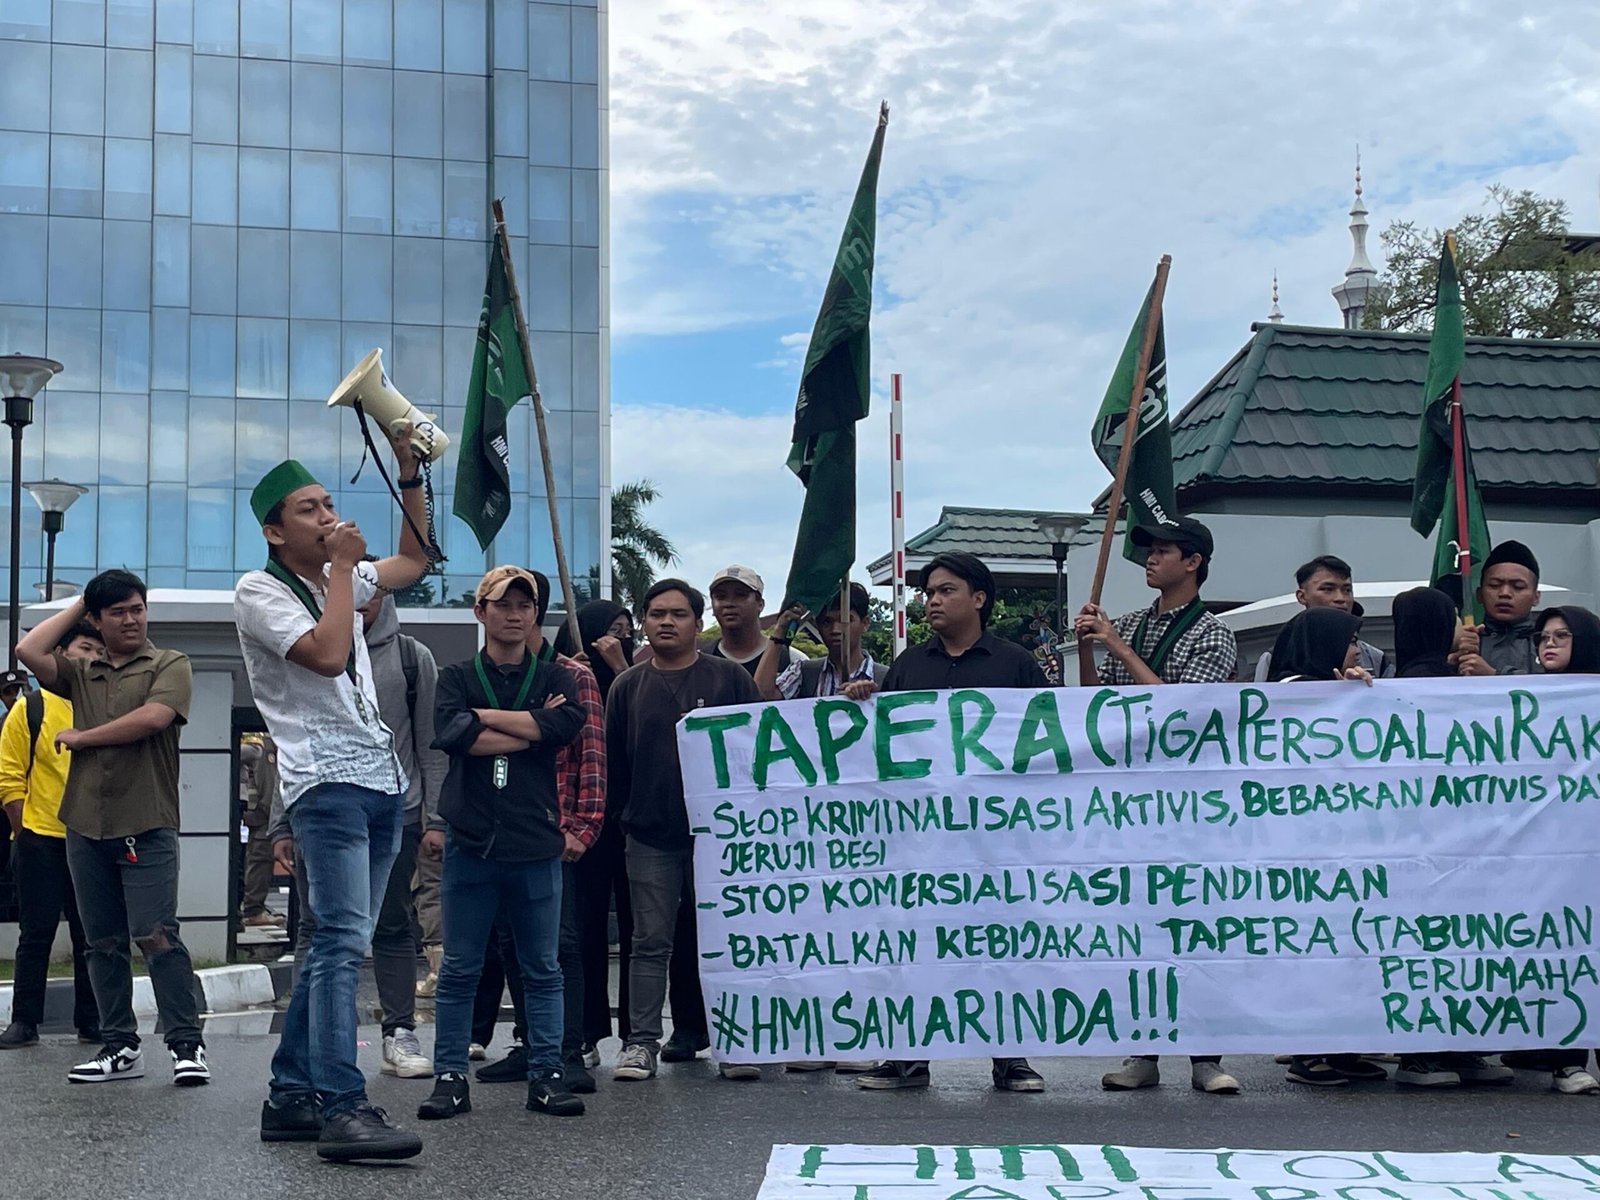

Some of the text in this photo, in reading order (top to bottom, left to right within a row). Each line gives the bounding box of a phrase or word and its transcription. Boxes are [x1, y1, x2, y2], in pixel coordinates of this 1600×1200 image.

[1139, 487, 1158, 508] HMI
[683, 689, 1073, 791] TAPERA
[1238, 687, 1505, 766] PERSOALAN
[803, 796, 1073, 837] KRIMINALISASI
[1083, 785, 1239, 828] AKTIVIS,
[1239, 777, 1424, 818] BEBASKAN
[1429, 773, 1548, 808] AKTIVIS
[1556, 772, 1600, 802] DA
[720, 838, 887, 876] JERUJI BESI
[822, 865, 1131, 913] KOMERSIALISASI
[1147, 863, 1389, 906] PENDIDIKAN
[936, 919, 1142, 960] KEBIJAKAN
[1156, 915, 1339, 955] TAPERA
[1351, 904, 1593, 954] (TABUNGAN
[1380, 989, 1588, 1047] RAKYAT)
